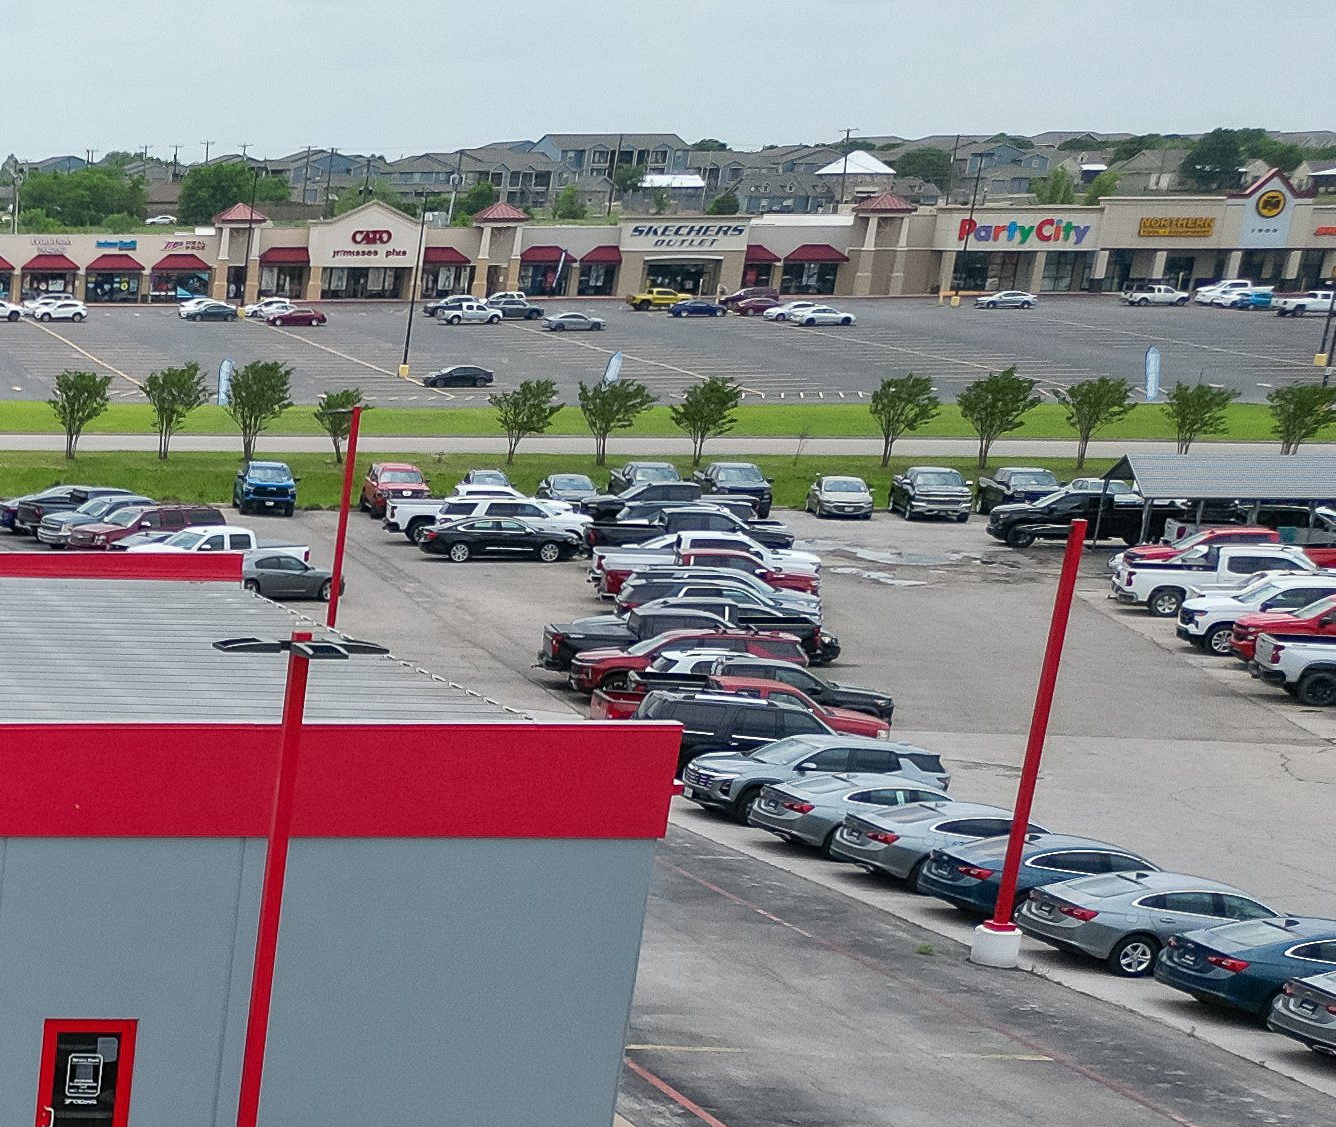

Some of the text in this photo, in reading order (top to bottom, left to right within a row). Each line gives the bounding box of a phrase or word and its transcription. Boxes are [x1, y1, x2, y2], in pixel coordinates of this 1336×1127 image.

[630, 225, 746, 236] SKECHERS
[352, 230, 392, 244] CATO
[654, 238, 719, 247] OUTLET
